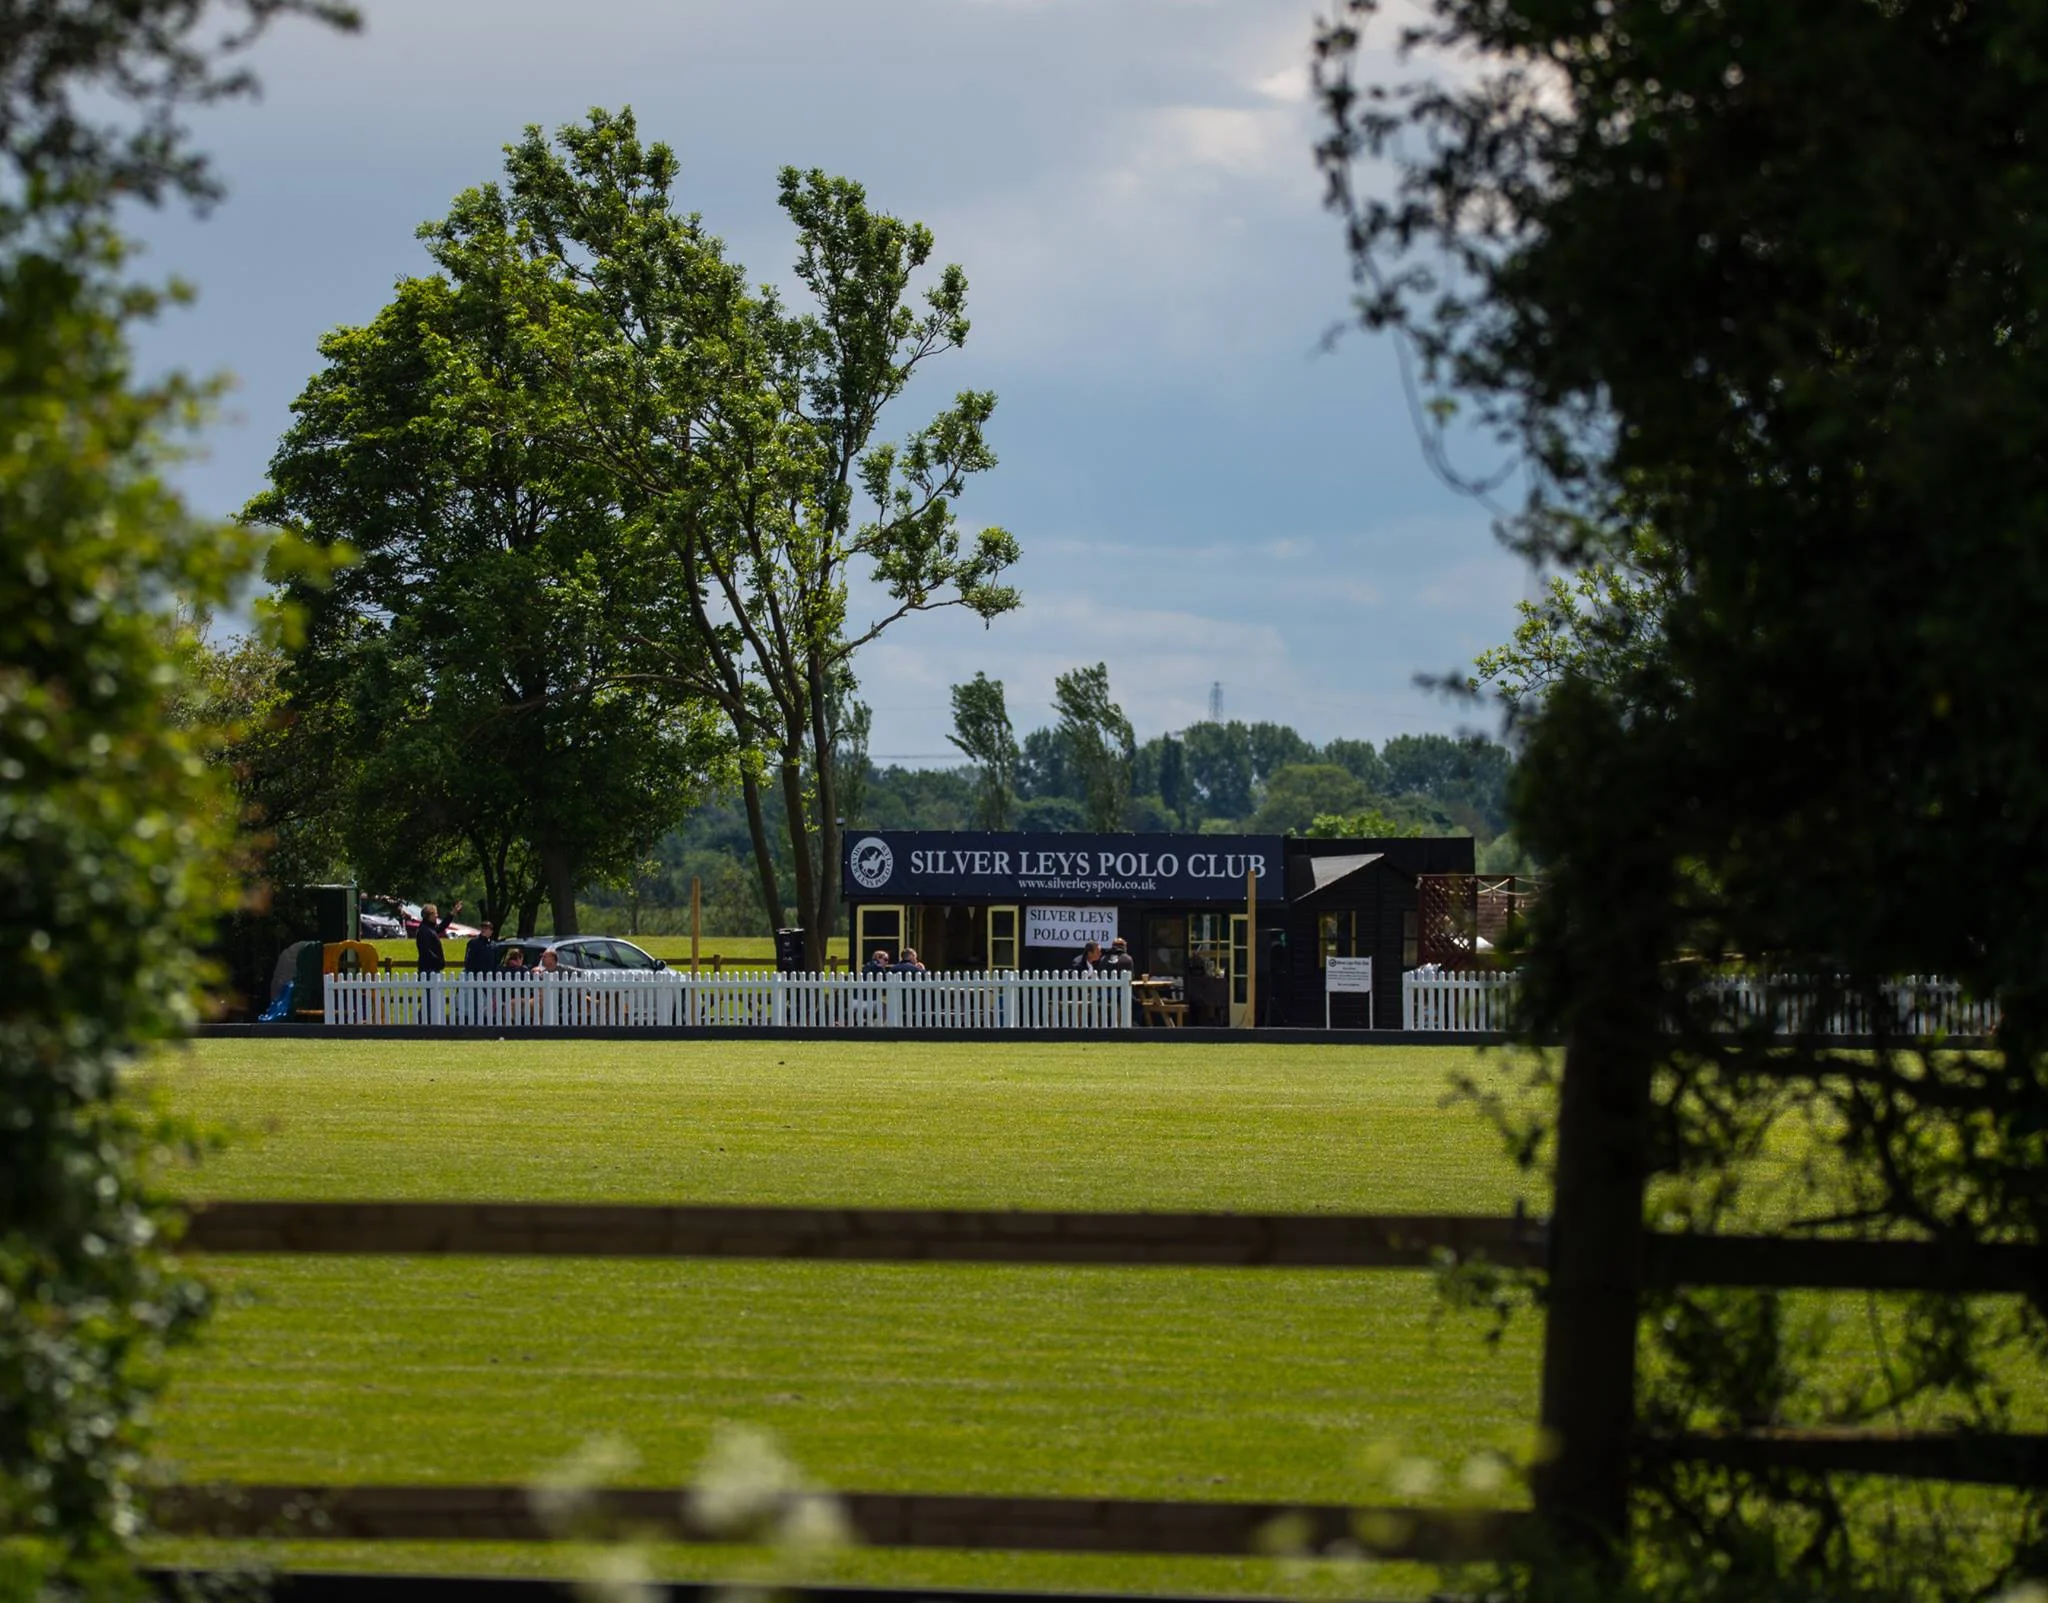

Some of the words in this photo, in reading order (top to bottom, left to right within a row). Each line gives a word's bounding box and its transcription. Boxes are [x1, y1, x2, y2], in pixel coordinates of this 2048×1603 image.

[910, 850, 1012, 875] SILVER
[1018, 851, 1090, 876] LEYS
[1097, 852, 1179, 877] POLO
[1187, 853, 1266, 878] CLUB
[1018, 877, 1156, 892] www.silverleyspolo.co.uk
[1030, 909, 1076, 922] SILVER
[1080, 911, 1113, 923] LEYS
[1033, 928, 1070, 941] POLO
[1073, 929, 1109, 942] CLUB
